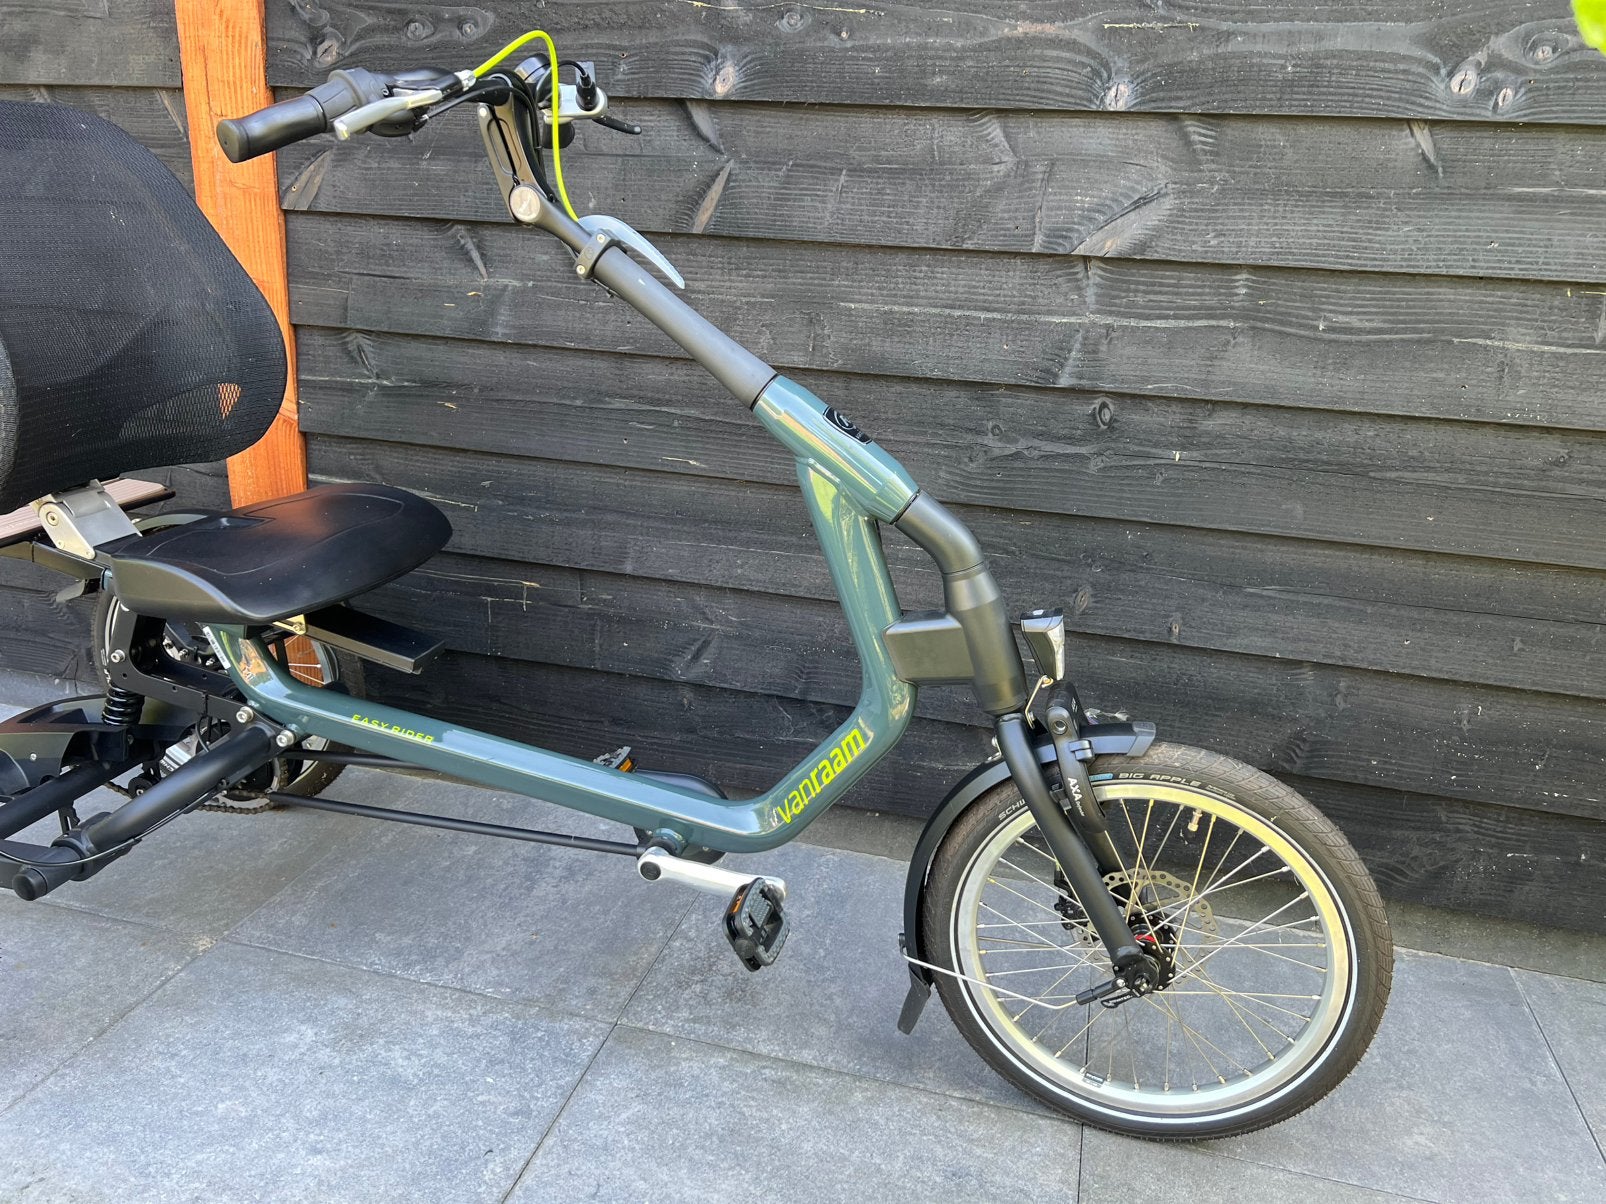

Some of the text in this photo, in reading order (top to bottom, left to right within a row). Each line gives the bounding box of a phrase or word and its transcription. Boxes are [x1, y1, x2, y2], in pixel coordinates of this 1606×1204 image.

[352, 714, 434, 743] EASY RIDER
[776, 728, 867, 824] vanraam
[1067, 777, 1082, 801] AXA
[1149, 774, 1202, 787] APPLE
